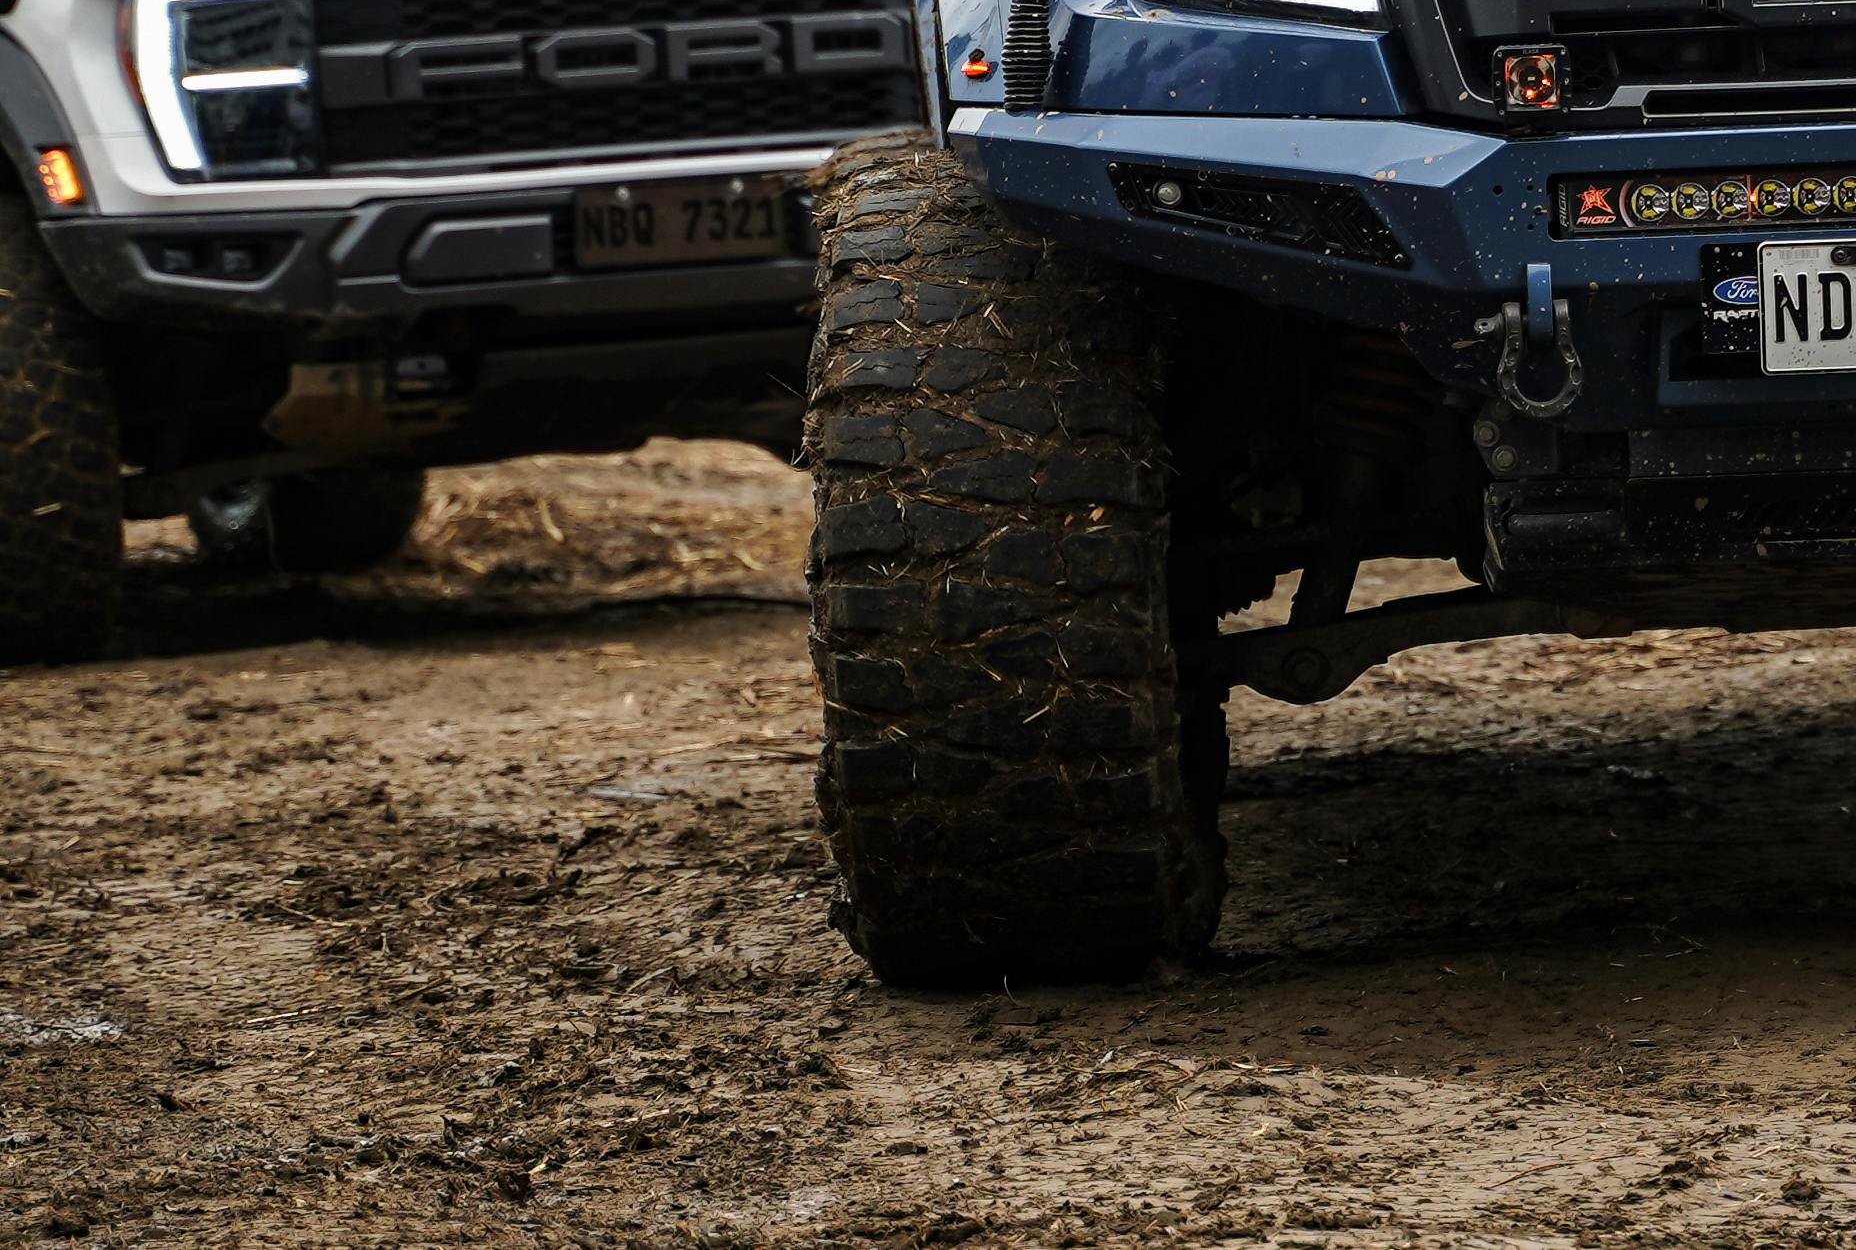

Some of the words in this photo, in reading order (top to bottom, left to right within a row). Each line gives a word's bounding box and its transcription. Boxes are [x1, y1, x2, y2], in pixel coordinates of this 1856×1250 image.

[397, 12, 910, 100] FORD
[583, 203, 655, 247] NBQ
[681, 196, 777, 242] 7321
[1576, 215, 1617, 225] RIGID
[1727, 280, 1758, 299] For
[1713, 309, 1759, 323] RAPT
